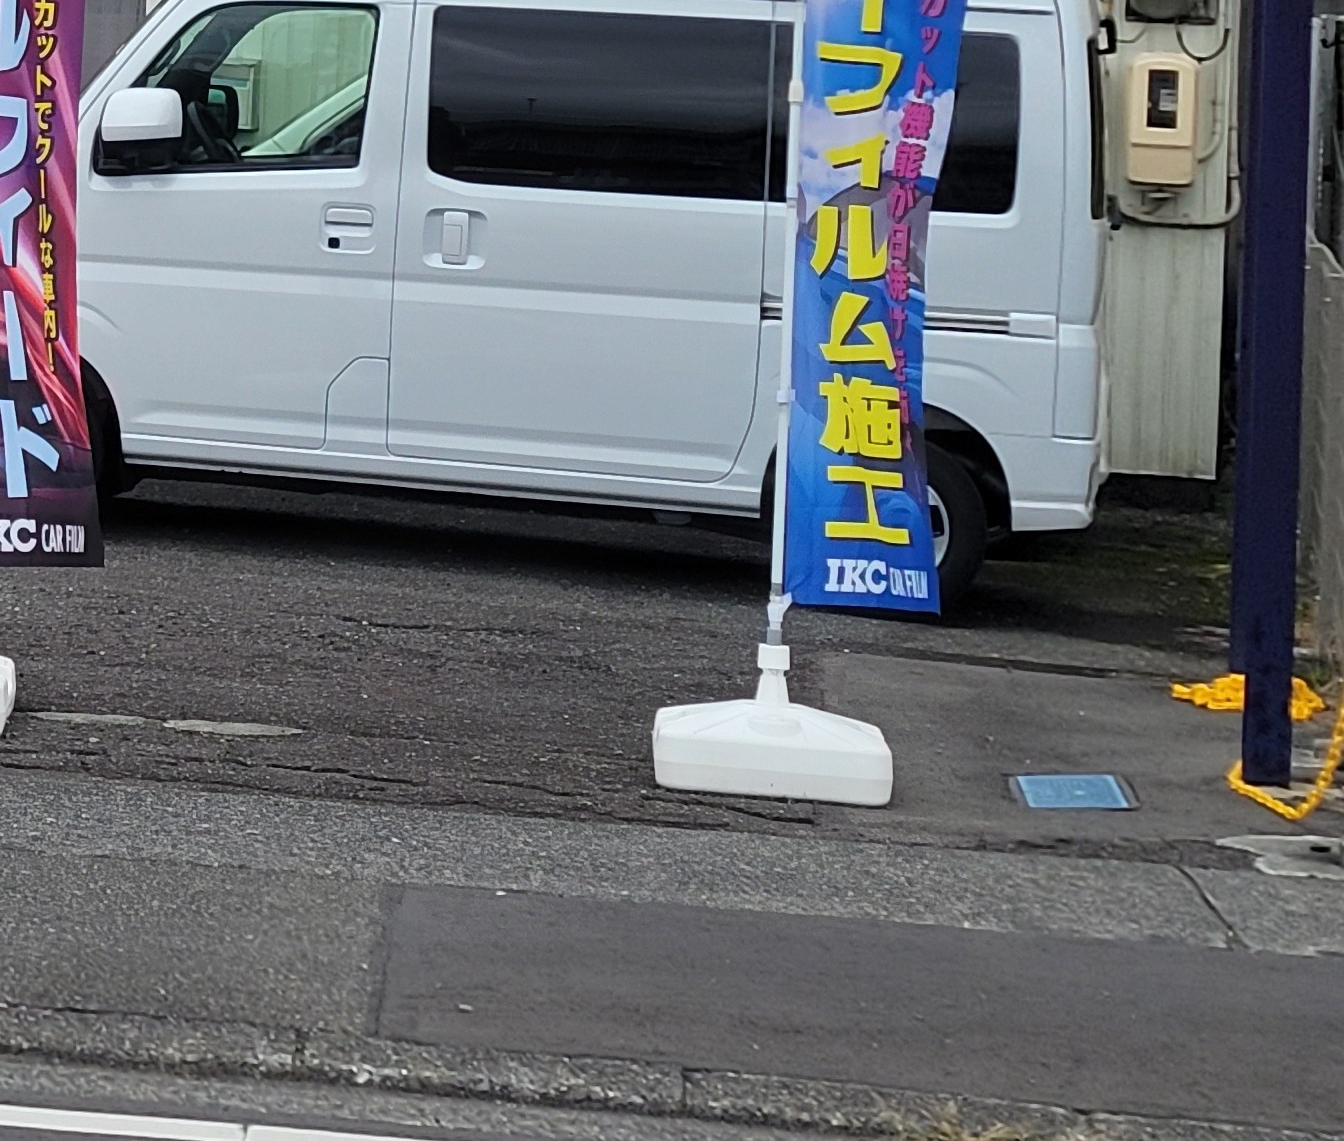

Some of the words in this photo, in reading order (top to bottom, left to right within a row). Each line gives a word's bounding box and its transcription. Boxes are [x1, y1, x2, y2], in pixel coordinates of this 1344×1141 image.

[41, 524, 64, 553] CAR
[66, 525, 86, 554] FILM
[824, 558, 888, 595] IKC
